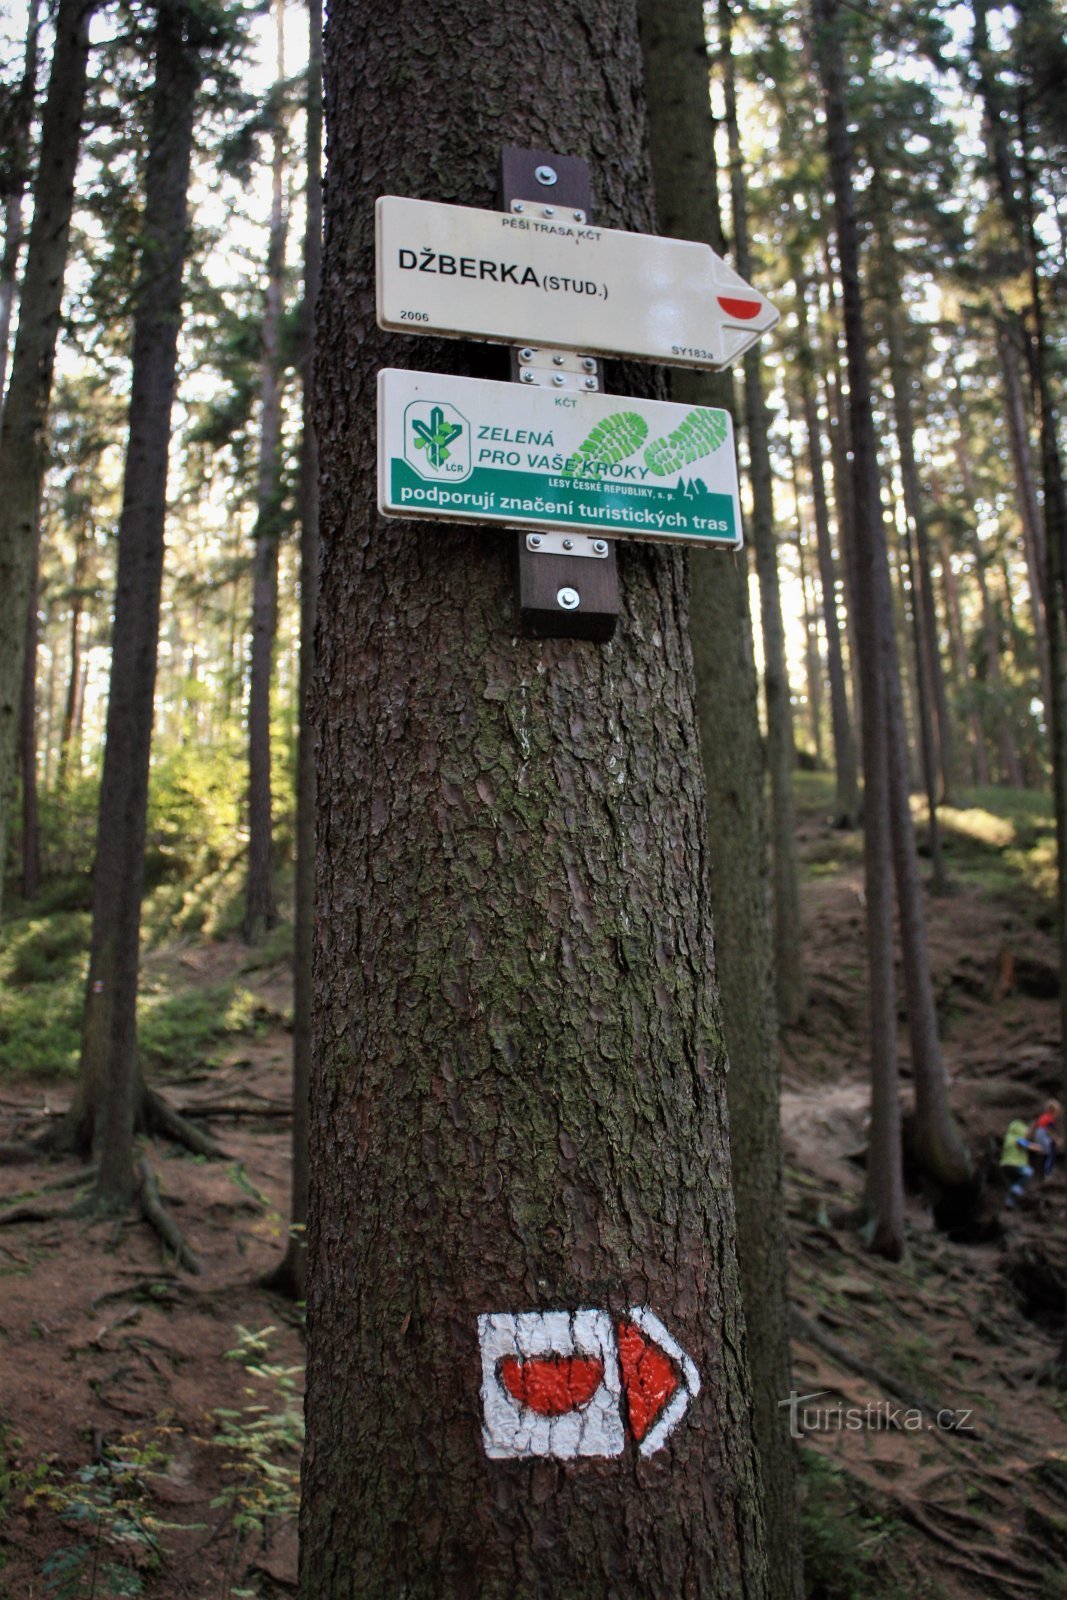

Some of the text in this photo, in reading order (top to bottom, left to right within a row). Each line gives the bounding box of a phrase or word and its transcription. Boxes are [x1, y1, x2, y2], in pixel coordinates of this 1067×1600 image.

[533, 223, 574, 237] TRASA
[577, 229, 602, 241] KČT
[399, 247, 608, 300] DŽBERKA (STUD.)
[400, 310, 429, 322] 2006
[672, 345, 713, 360] SY183a
[555, 397, 577, 408] KČT
[477, 425, 554, 447] ZELENÁ
[478, 449, 649, 480] PRO VAŠE KROKY
[549, 478, 570, 489] LESY
[572, 479, 601, 492] ČESKÉ
[604, 484, 656, 500] REPUBLIKY,
[401, 486, 728, 531] podporují značení turistických tras
